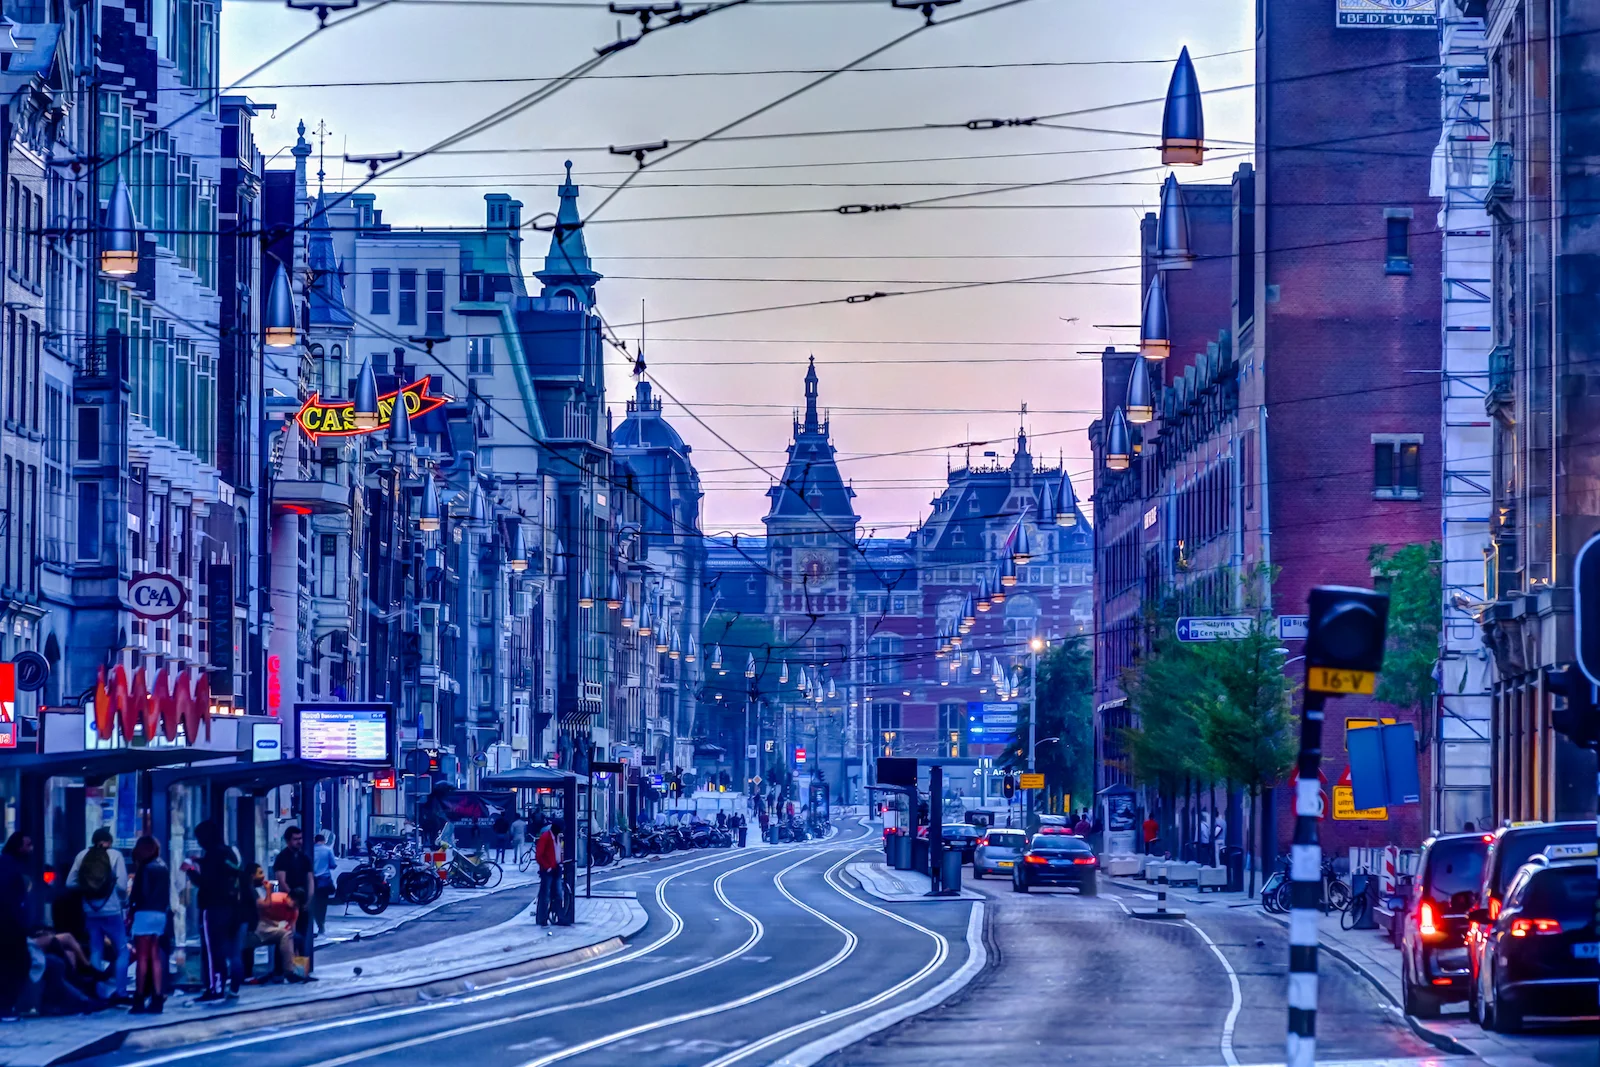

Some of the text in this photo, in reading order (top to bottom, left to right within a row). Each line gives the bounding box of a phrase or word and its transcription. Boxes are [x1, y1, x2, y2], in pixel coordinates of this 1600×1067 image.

[1347, 13, 1387, 24] BEIDT
[1393, 14, 1415, 24] UW
[302, 391, 421, 431] CASNO
[134, 585, 176, 607] C&A
[215, 579, 229, 682] PRIMAR
[1322, 670, 1364, 691] 16-V
[1565, 846, 1584, 854] TCS
